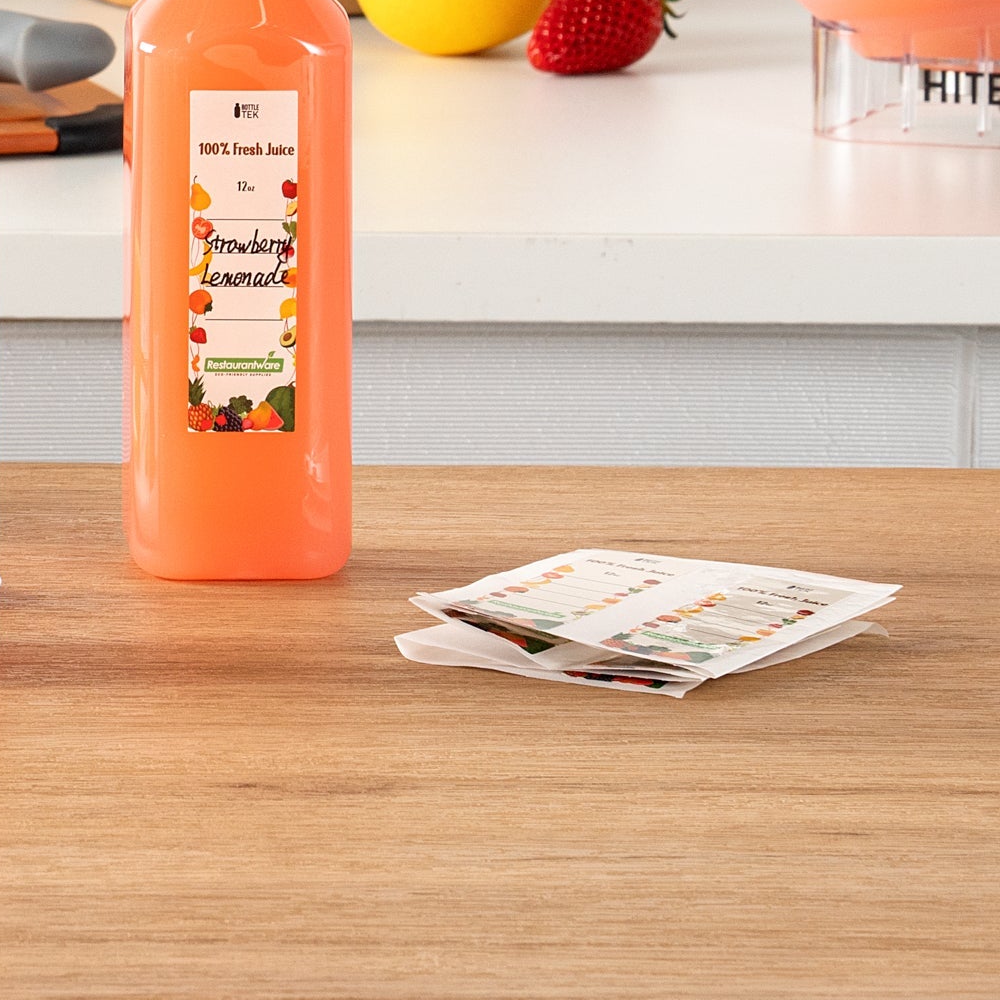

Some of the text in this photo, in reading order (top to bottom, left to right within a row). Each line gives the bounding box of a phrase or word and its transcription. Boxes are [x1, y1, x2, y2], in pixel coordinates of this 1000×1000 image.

[241, 103, 259, 111] BOTTLE
[241, 111, 259, 119] TEK
[199, 142, 295, 156] 100% Fresh Juice
[203, 228, 292, 263] Strawberry
[201, 262, 290, 287] Lemonade
[206, 357, 281, 370] Restaurantware
